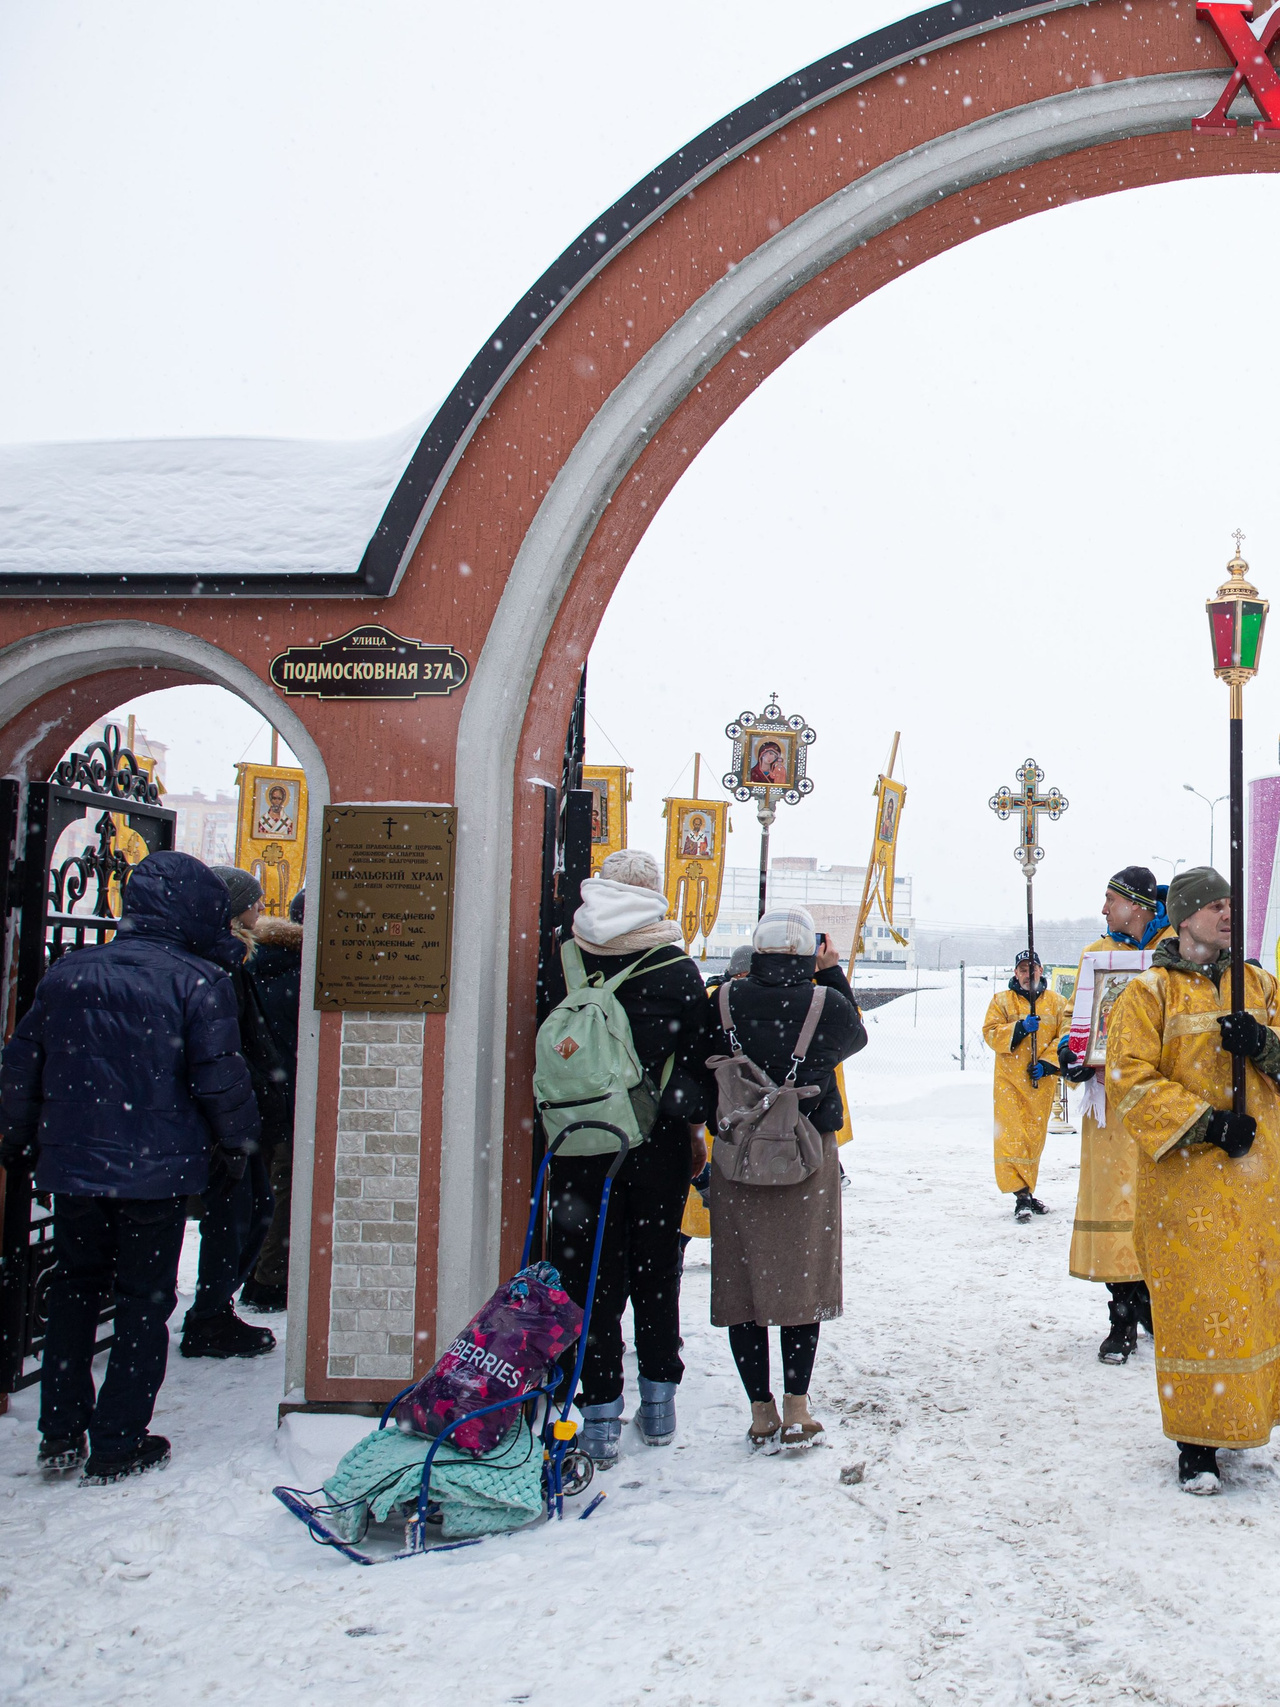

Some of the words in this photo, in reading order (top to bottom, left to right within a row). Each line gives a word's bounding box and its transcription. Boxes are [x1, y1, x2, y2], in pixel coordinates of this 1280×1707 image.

[352, 637, 387, 646] УЛИЦА
[283, 663, 418, 682] ПОДМОСКОВНАЯ
[423, 663, 454, 680] 37А
[331, 869, 405, 880] НИКОЛЬСКИЙ
[411, 871, 444, 881] ХРАМ
[356, 924, 367, 933] 10
[372, 926, 384, 935] до
[391, 924, 401, 934] 18
[356, 951, 363, 960] 8
[387, 951, 398, 960] 19
